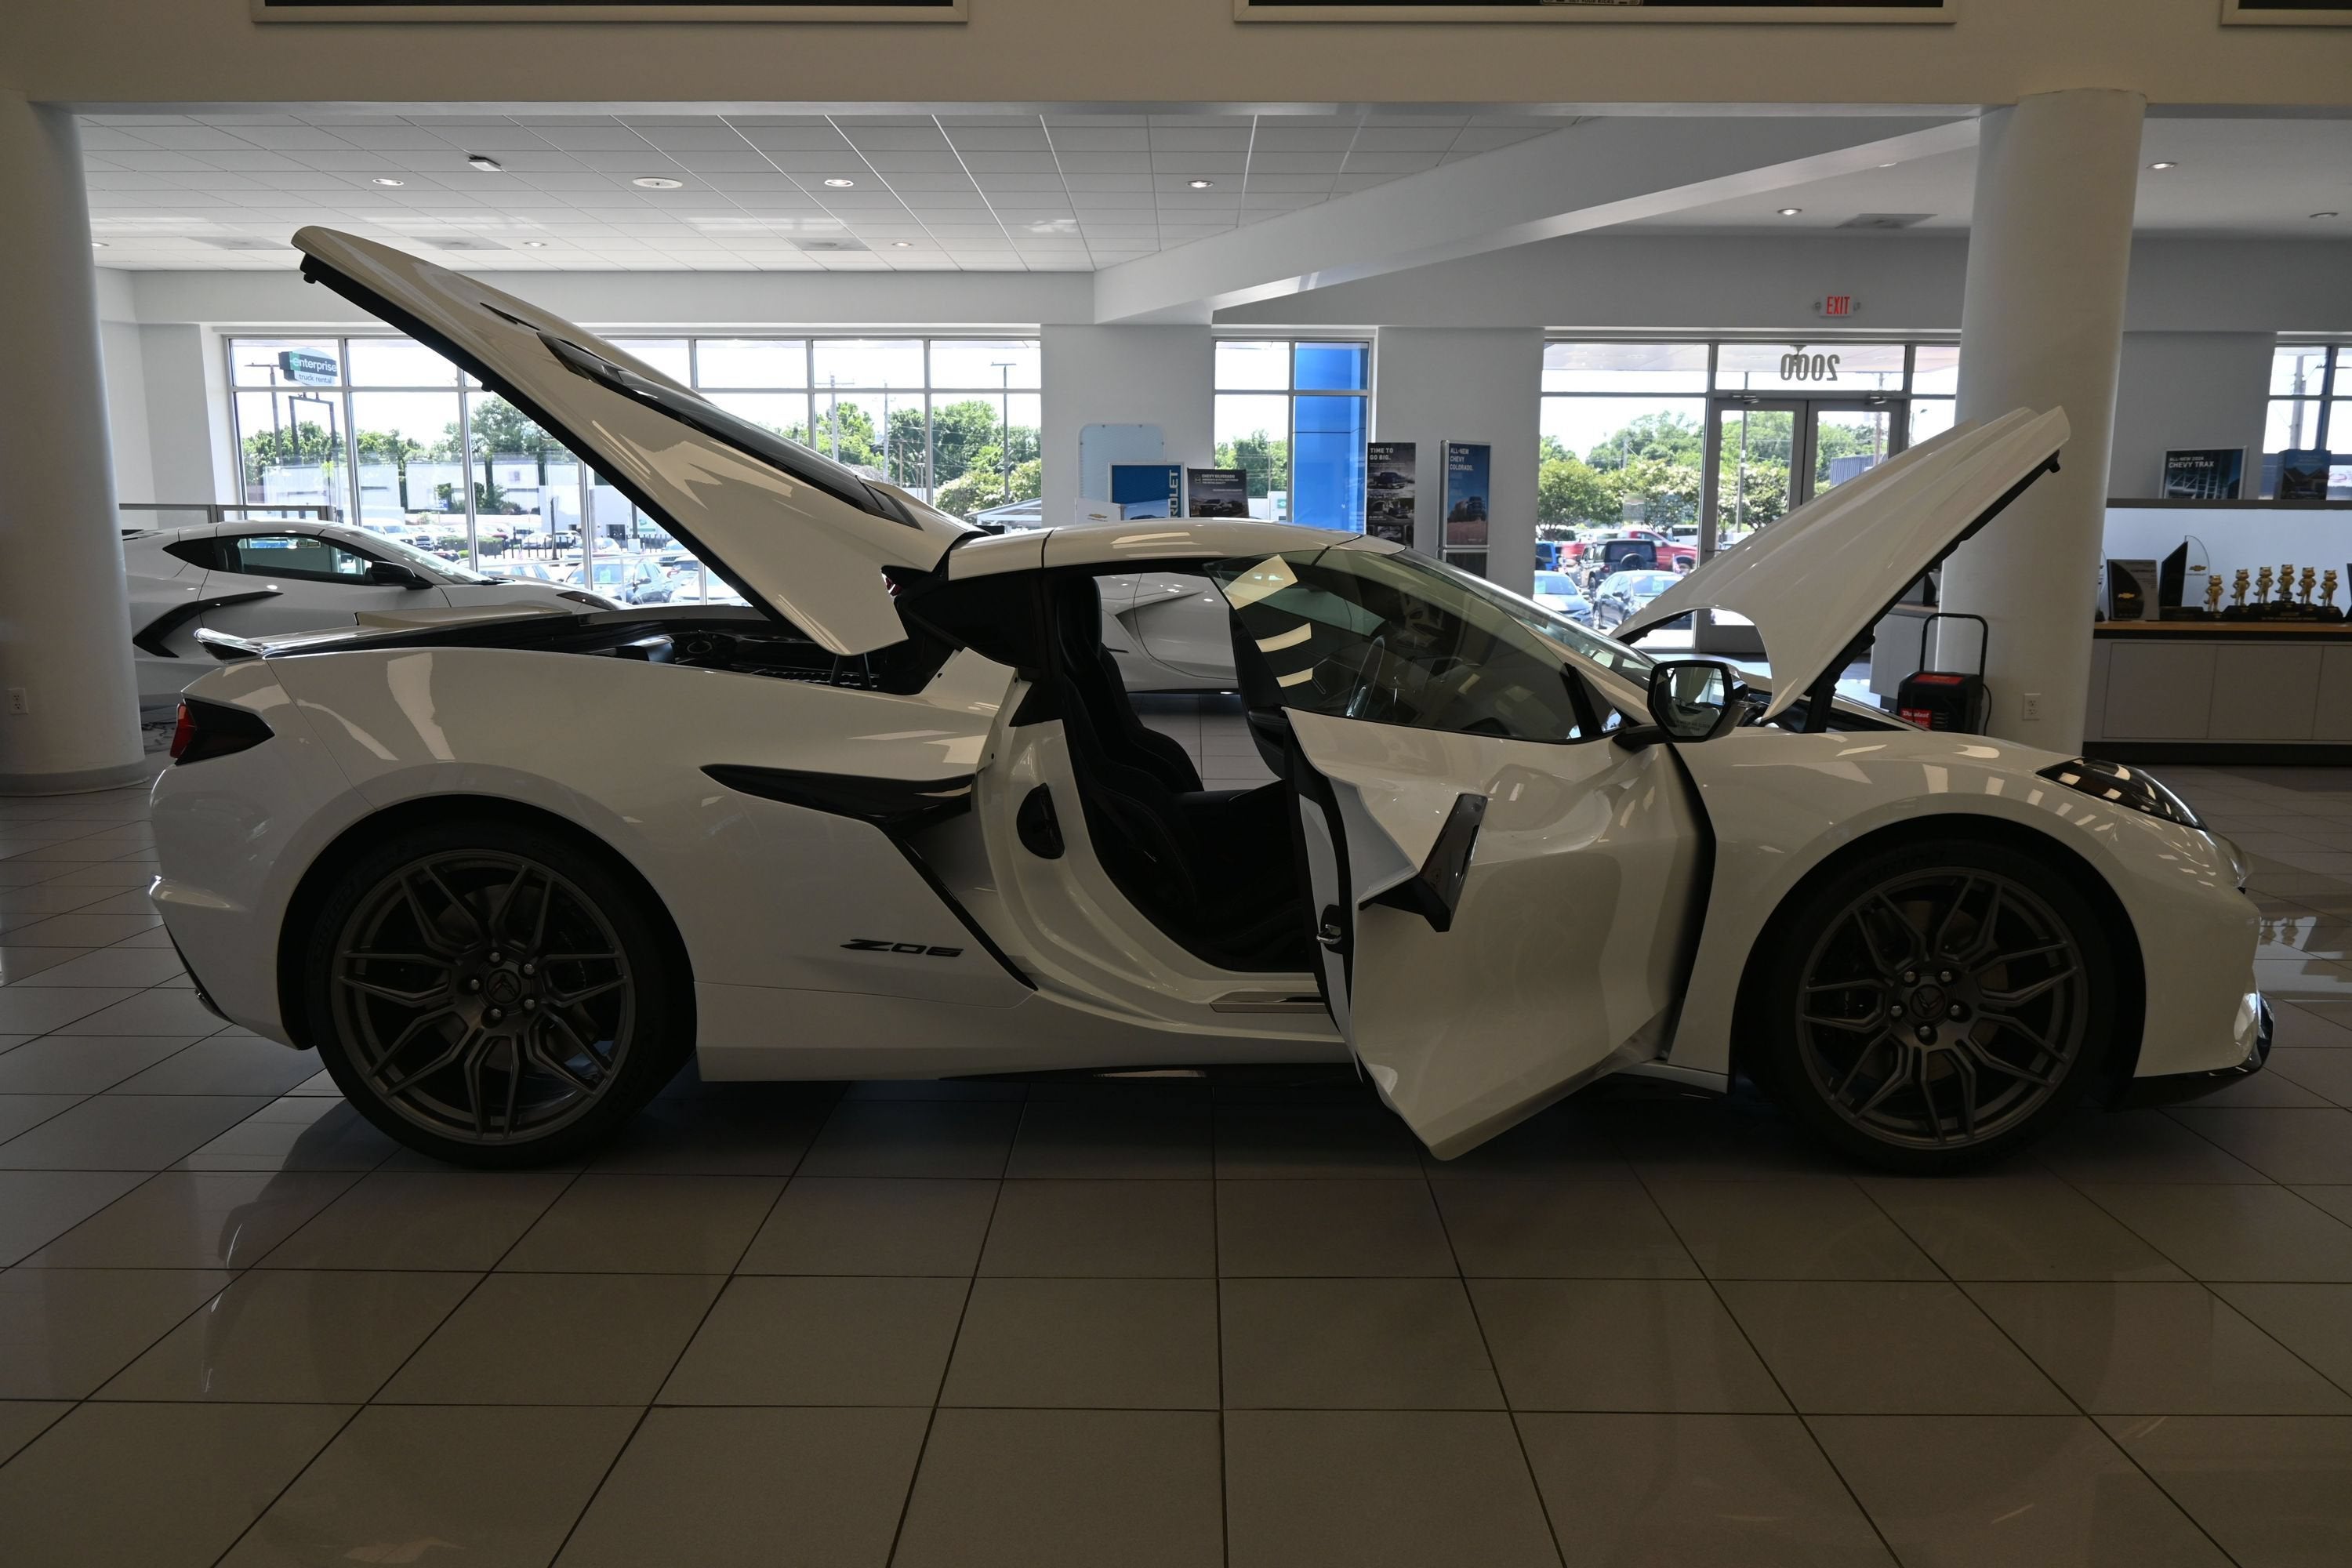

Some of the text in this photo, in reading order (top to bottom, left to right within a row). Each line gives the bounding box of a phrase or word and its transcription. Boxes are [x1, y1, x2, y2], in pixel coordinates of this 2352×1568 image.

[1827, 296, 1850, 314] EXIT
[291, 357, 337, 372] enterprise
[299, 373, 314, 382] truck
[840, 938, 964, 957] Z06
